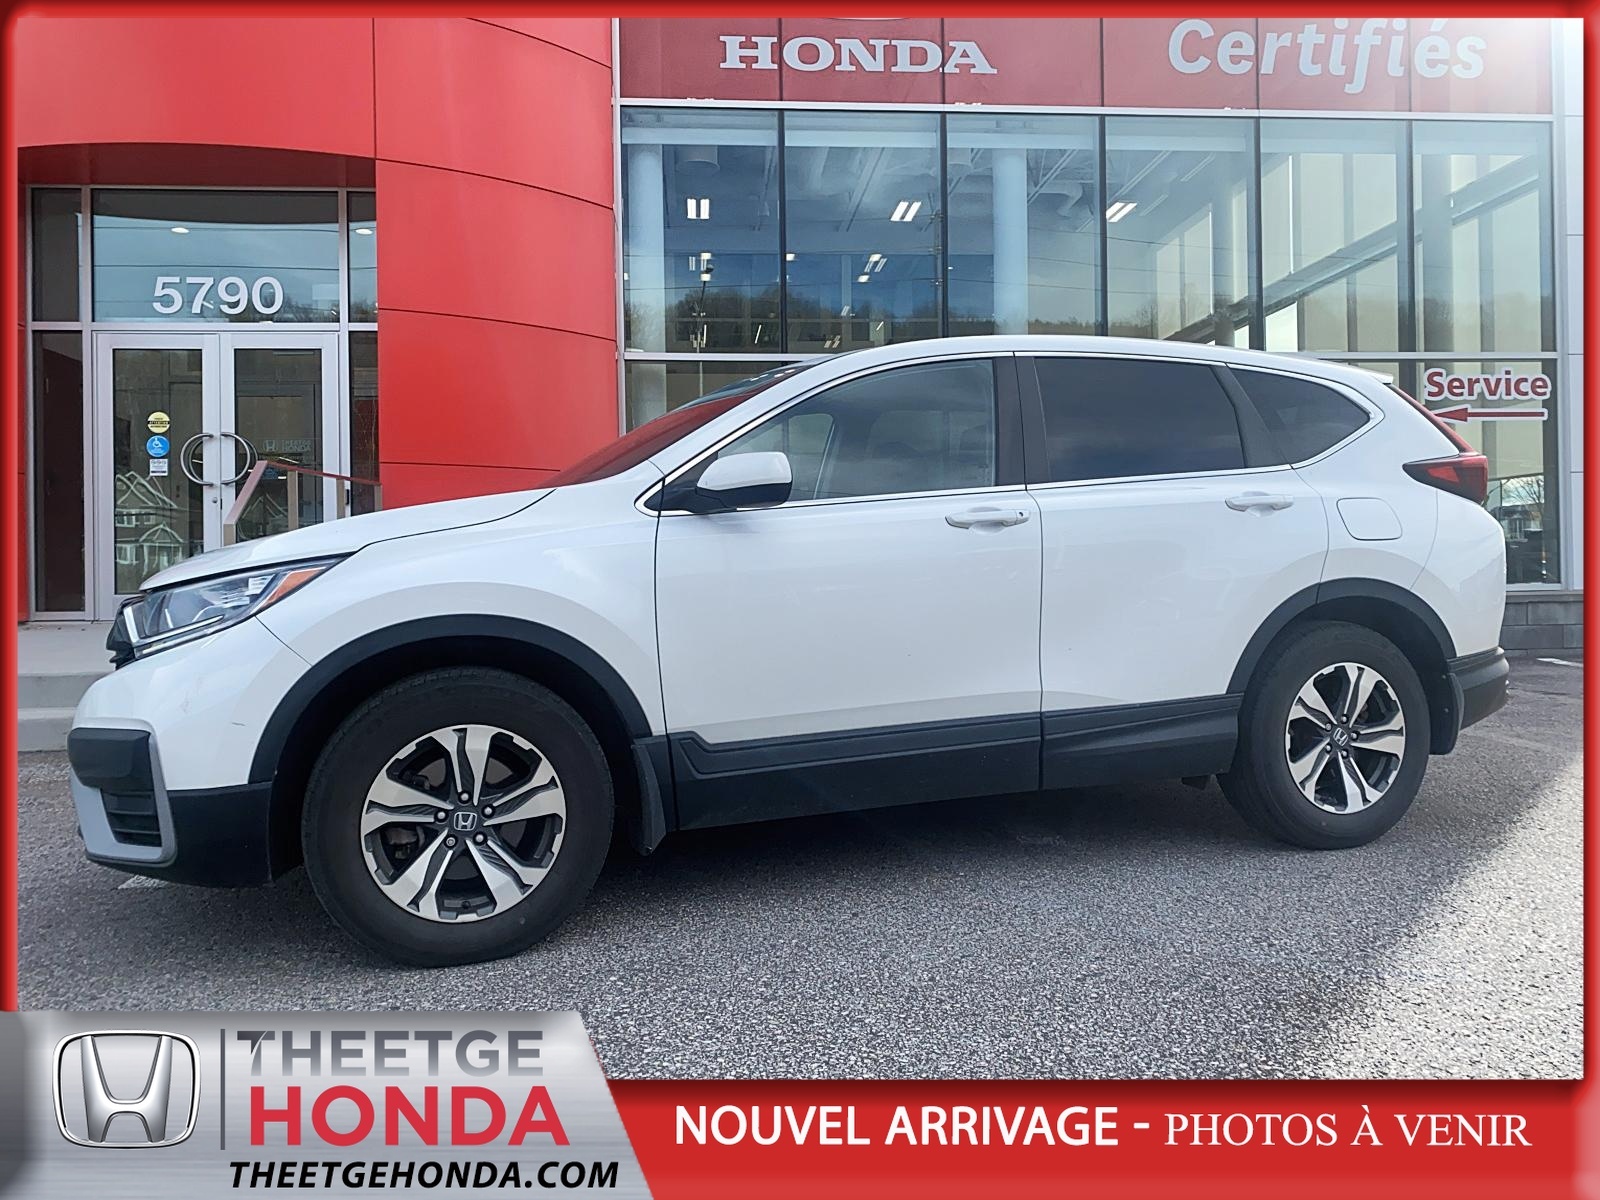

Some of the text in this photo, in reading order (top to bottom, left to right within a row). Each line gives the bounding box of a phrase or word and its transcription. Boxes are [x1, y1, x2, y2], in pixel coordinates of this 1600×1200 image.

[720, 36, 998, 75] HONDA
[1168, 19, 1487, 95] Certifiés
[152, 276, 284, 315] 5790
[1426, 369, 1549, 399] Service
